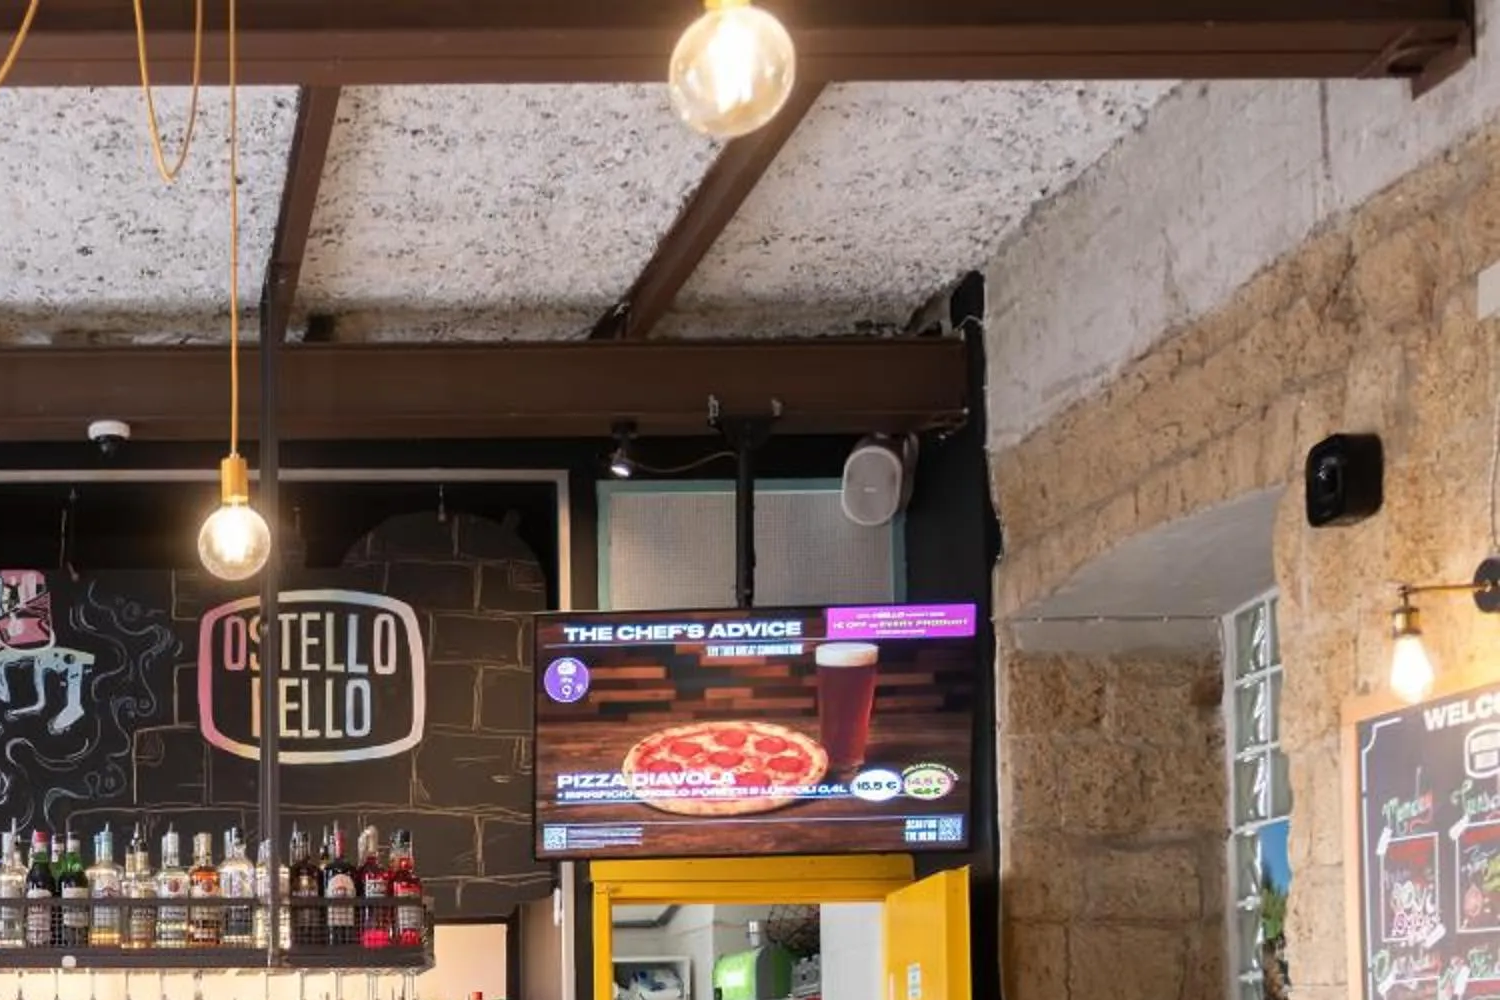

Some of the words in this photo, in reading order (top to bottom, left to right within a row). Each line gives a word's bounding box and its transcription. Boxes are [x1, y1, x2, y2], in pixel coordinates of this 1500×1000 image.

[564, 626, 613, 641] THE
[616, 624, 704, 640] CHEF'S
[708, 621, 802, 638] ADVICE
[557, 773, 626, 788] PIZZA
[632, 771, 736, 786] DIAVOLA
